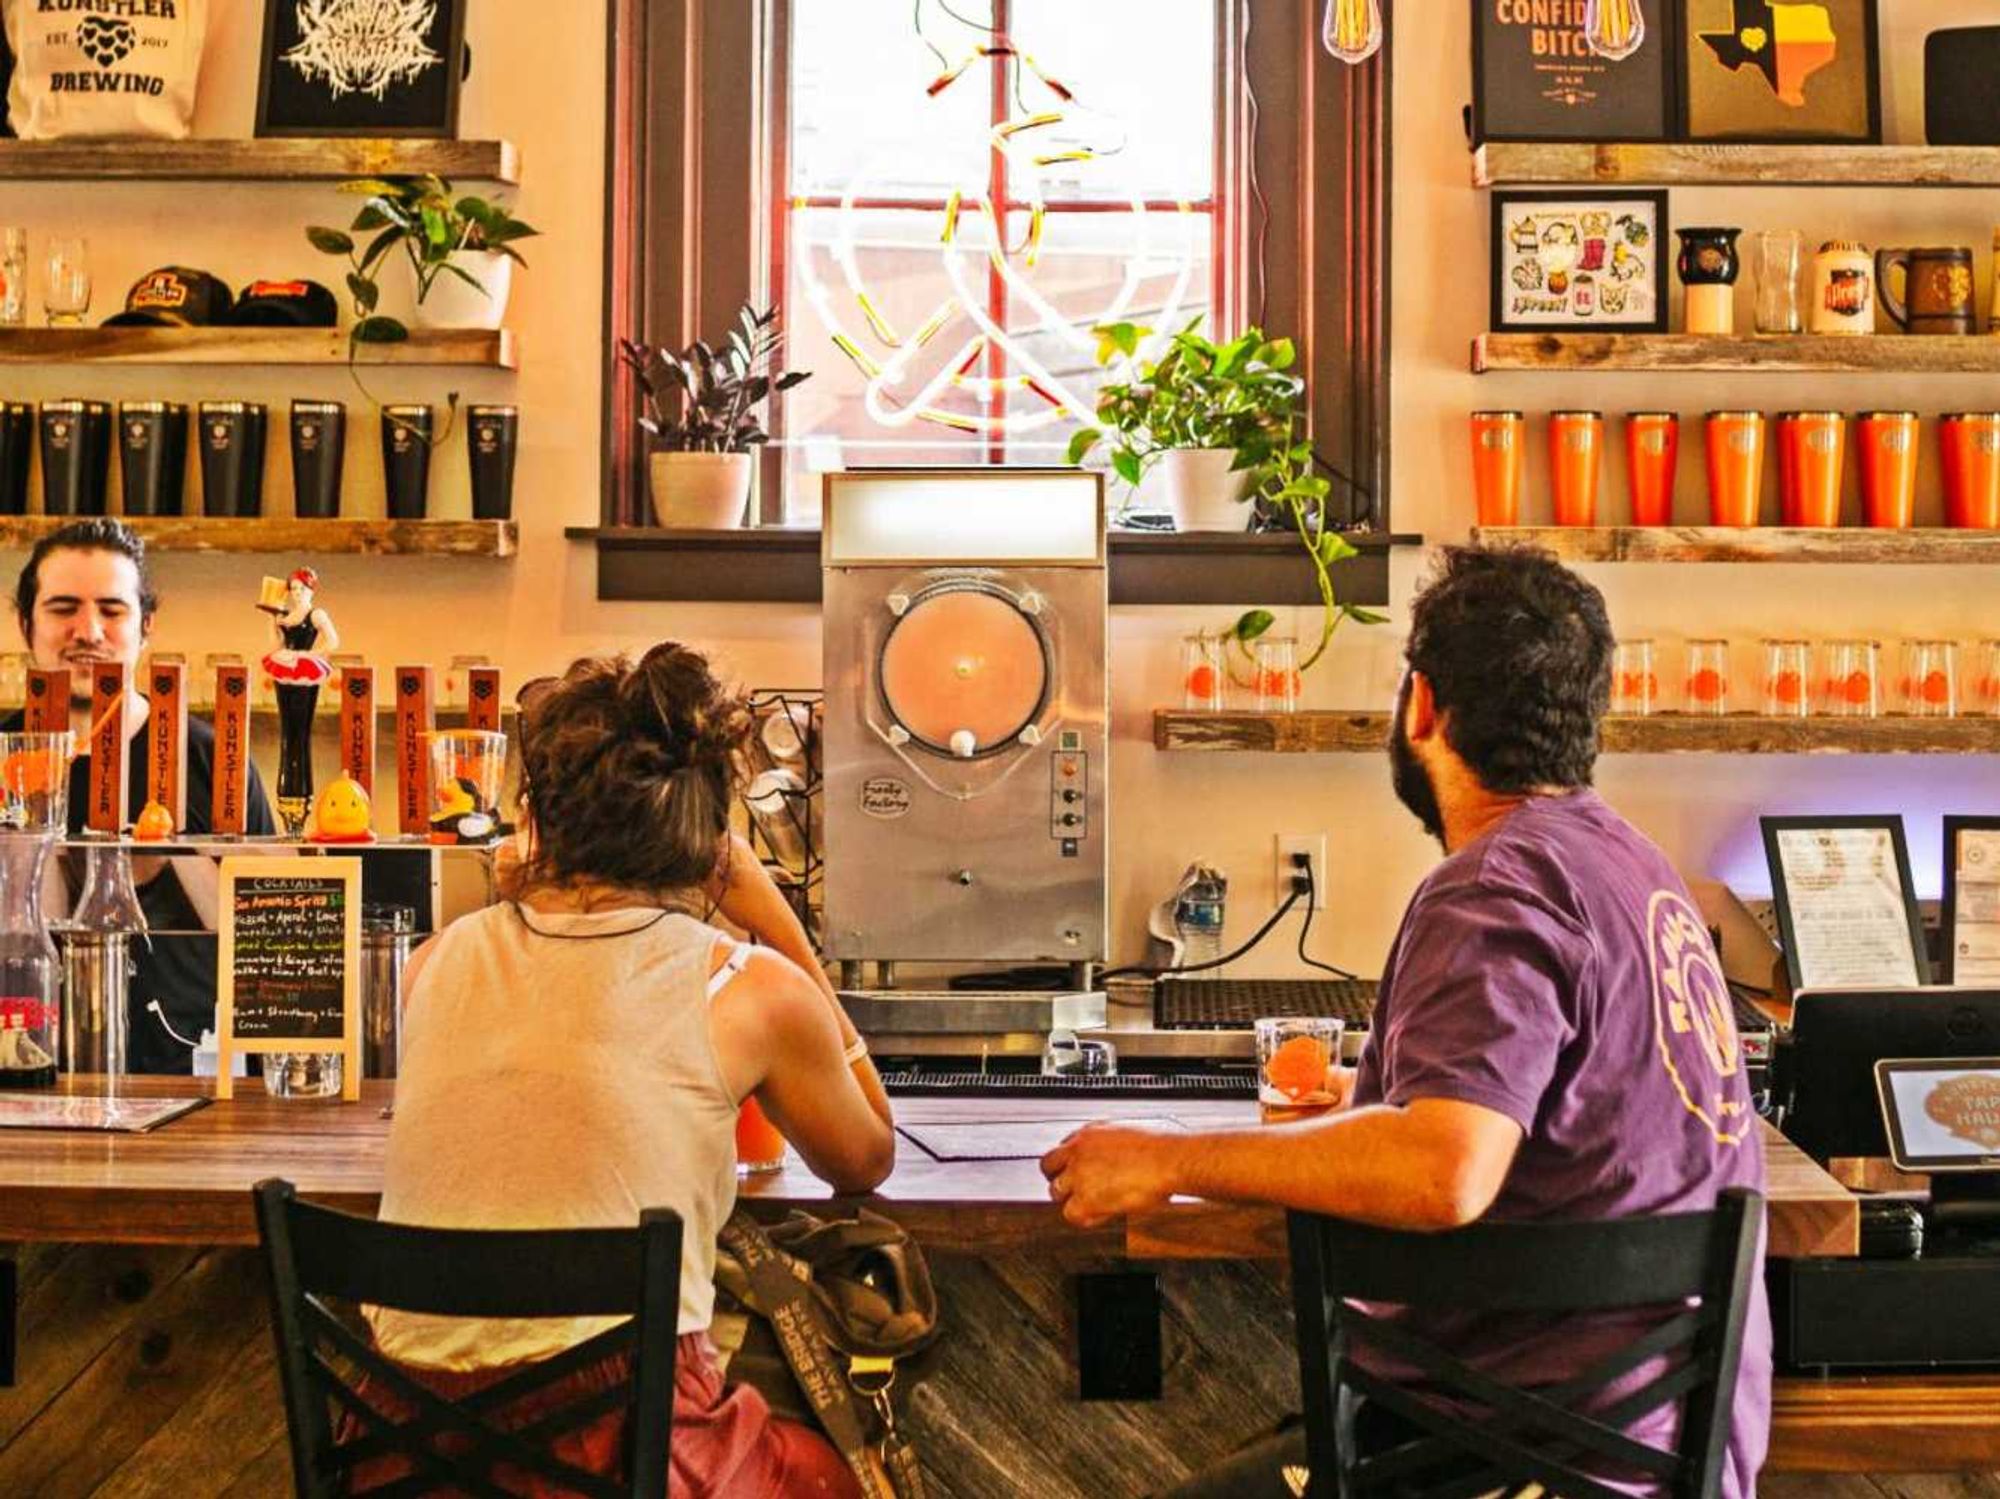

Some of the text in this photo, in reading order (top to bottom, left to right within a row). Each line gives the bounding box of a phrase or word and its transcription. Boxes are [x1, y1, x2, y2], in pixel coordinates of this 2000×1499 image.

[50, 71, 164, 96] BREWING
[157, 709, 168, 805] KUNSTLE
[352, 714, 363, 780] KUNST
[864, 781, 902, 799] Frosty
[864, 795, 909, 811] Factory
[774, 1304, 832, 1409] THE BRIDGE
